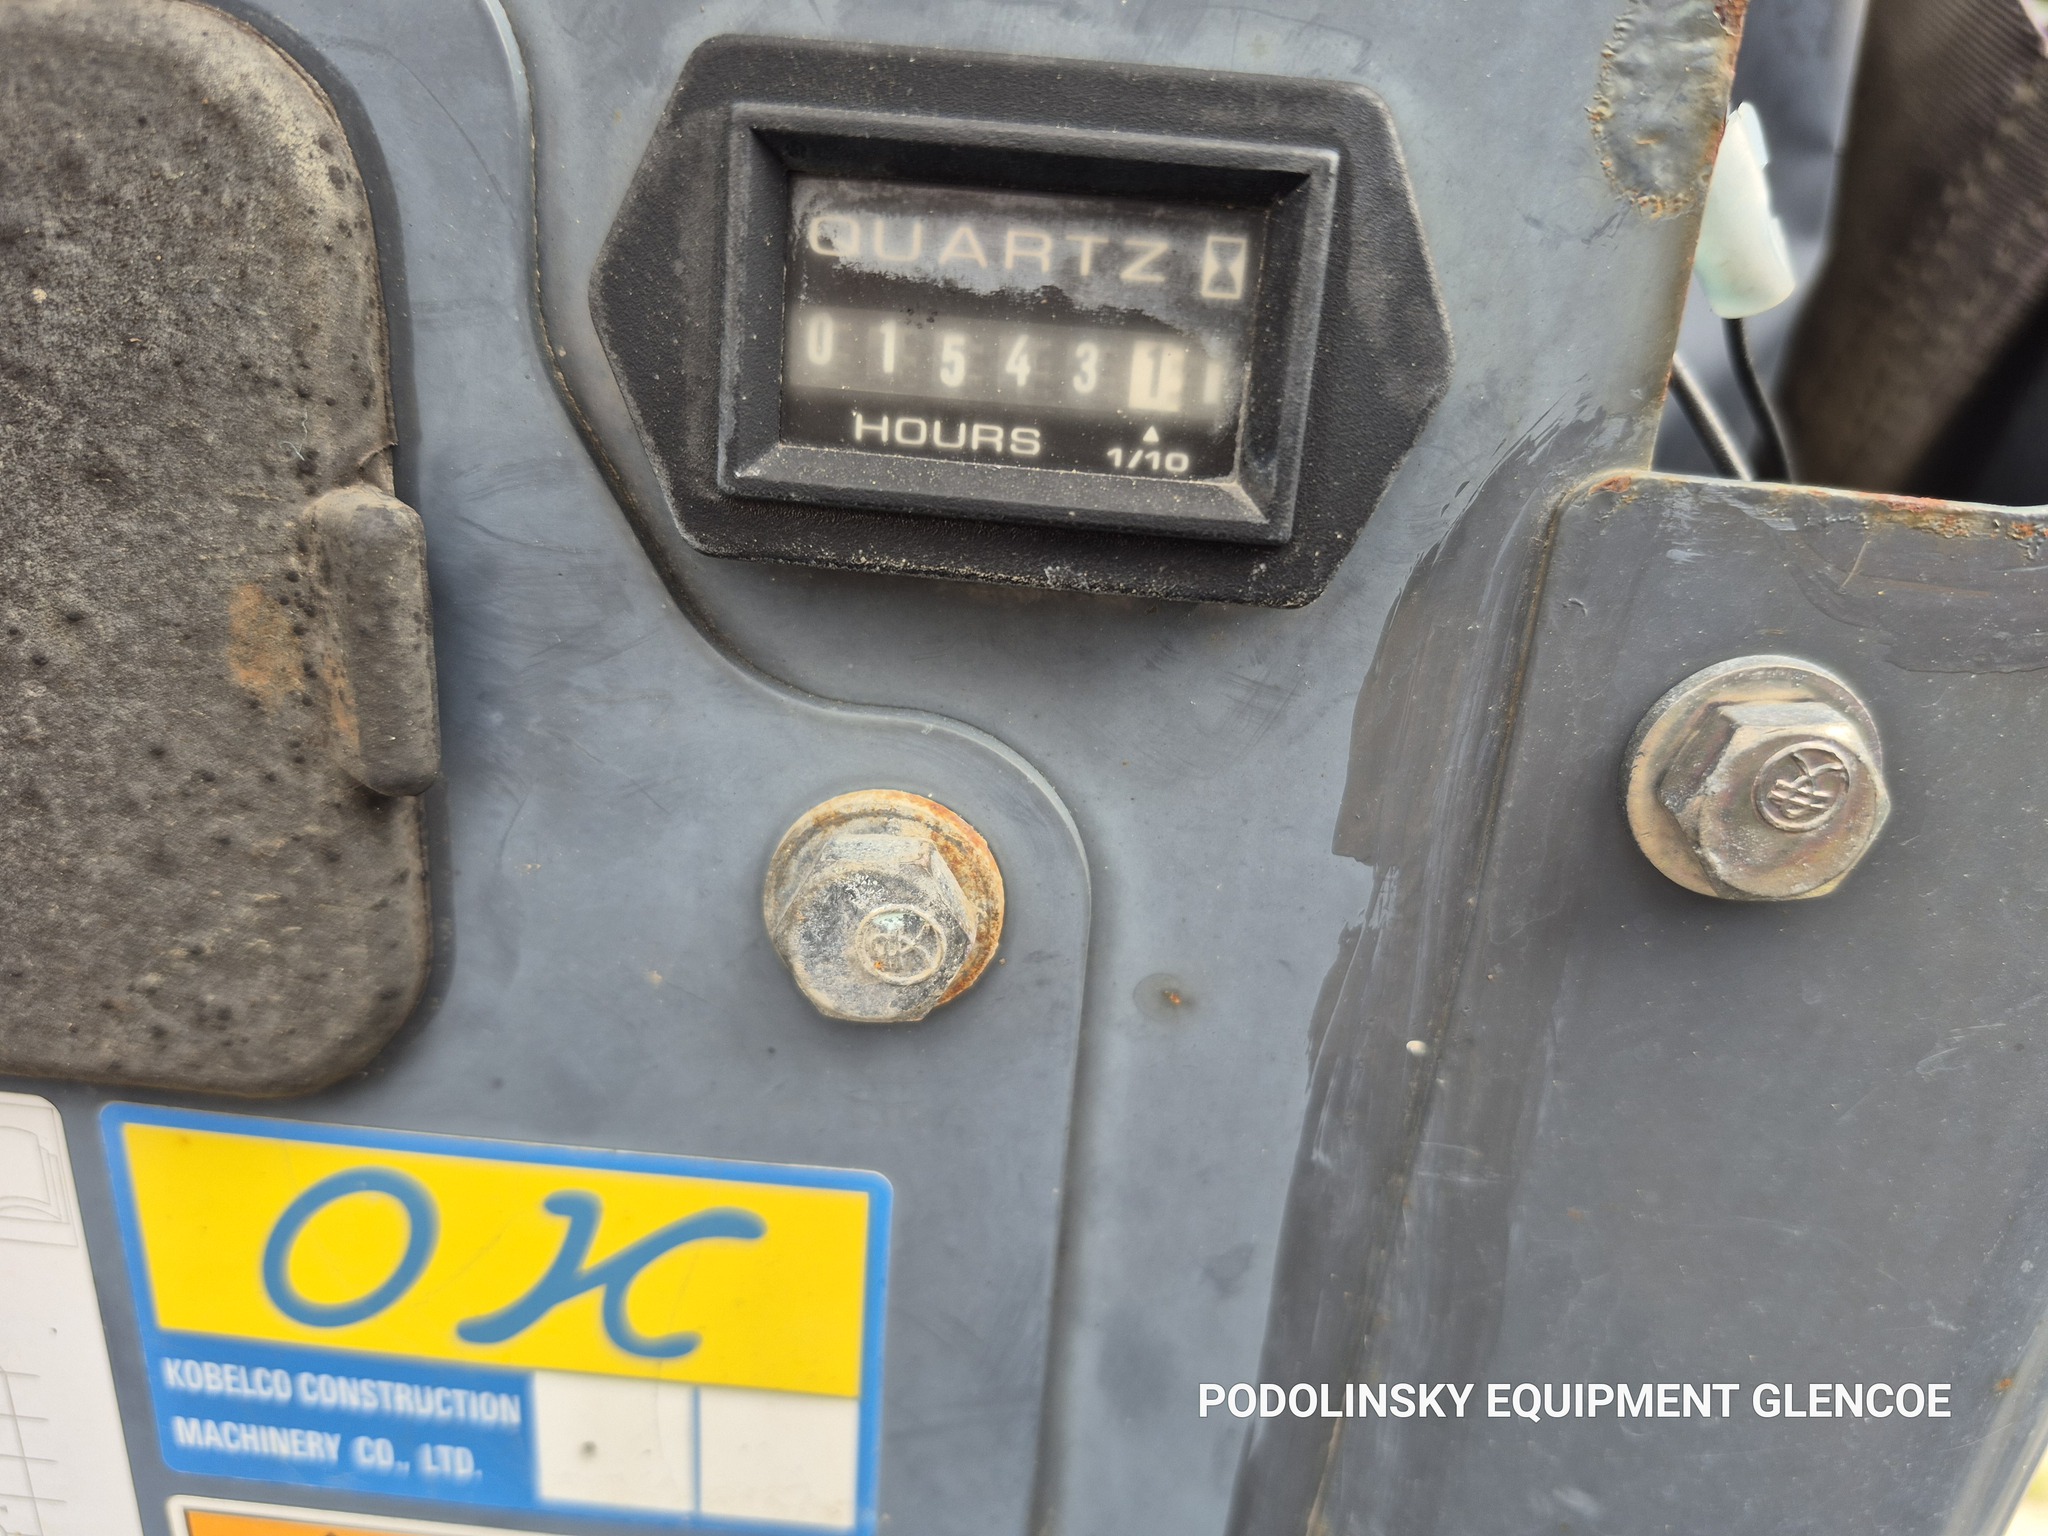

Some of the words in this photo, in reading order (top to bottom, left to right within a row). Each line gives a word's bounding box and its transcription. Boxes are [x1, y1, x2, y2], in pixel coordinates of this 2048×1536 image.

[808, 214, 1169, 283] QUARTZ
[854, 412, 1042, 456] HOURS
[1106, 446, 1190, 474] 1/10
[262, 1166, 768, 1358] OK
[163, 1358, 293, 1402] KOBELCO
[299, 1373, 520, 1424] CONSTRUCTION
[174, 1416, 341, 1463] MACHINERY
[421, 1442, 483, 1478] LTD.
